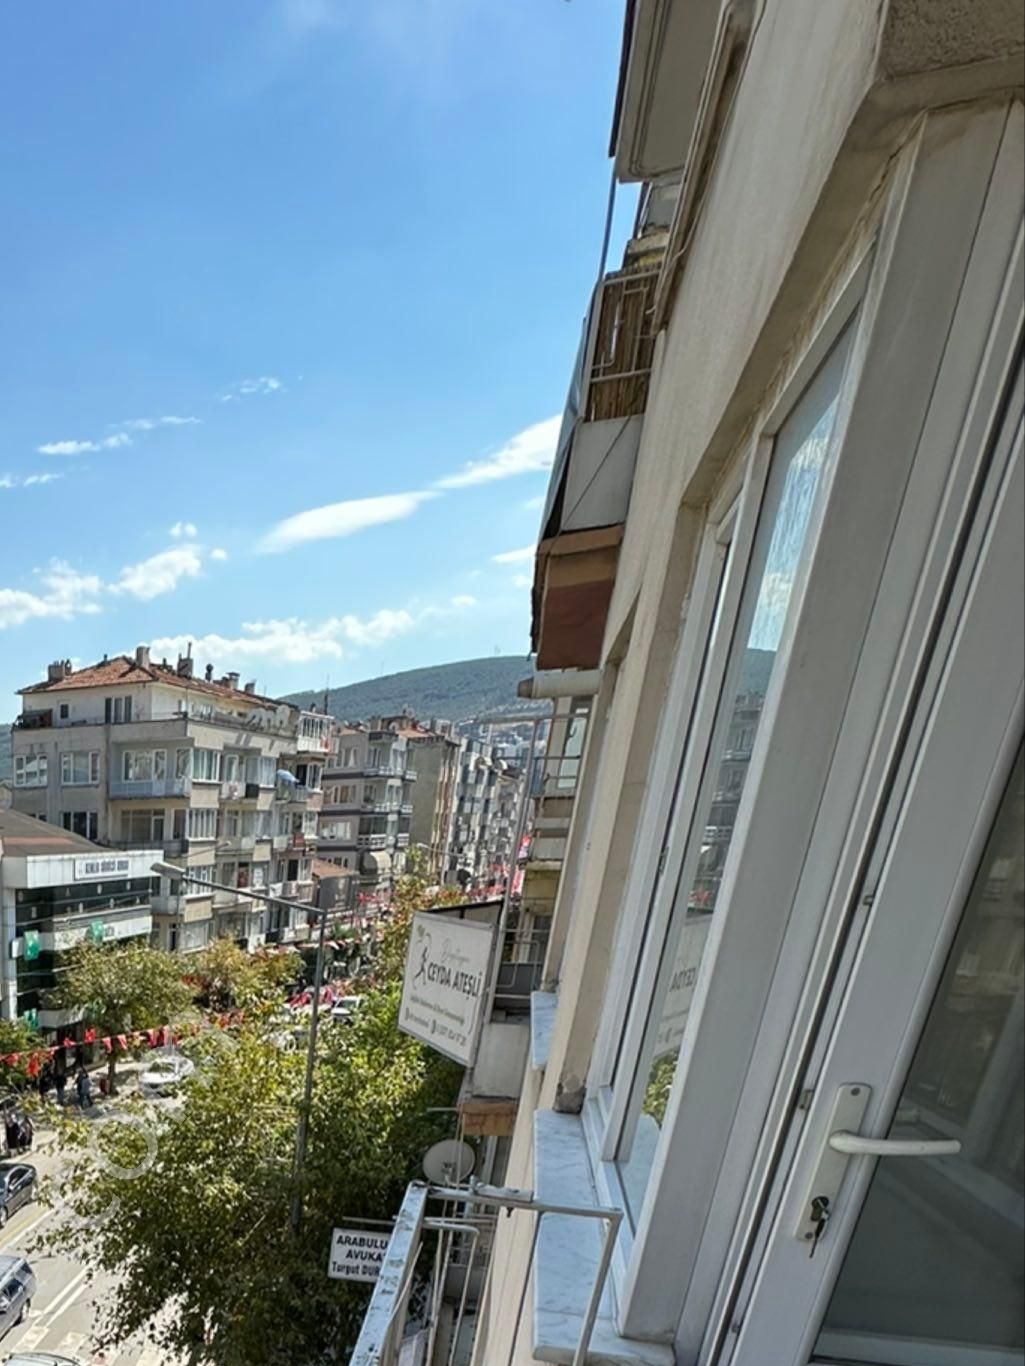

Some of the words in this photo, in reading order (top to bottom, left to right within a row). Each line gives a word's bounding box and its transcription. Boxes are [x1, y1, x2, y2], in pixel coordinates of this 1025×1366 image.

[427, 962, 452, 987] CEYDA
[336, 1234, 389, 1250] ARABULU
[345, 1249, 386, 1262] AVUKA
